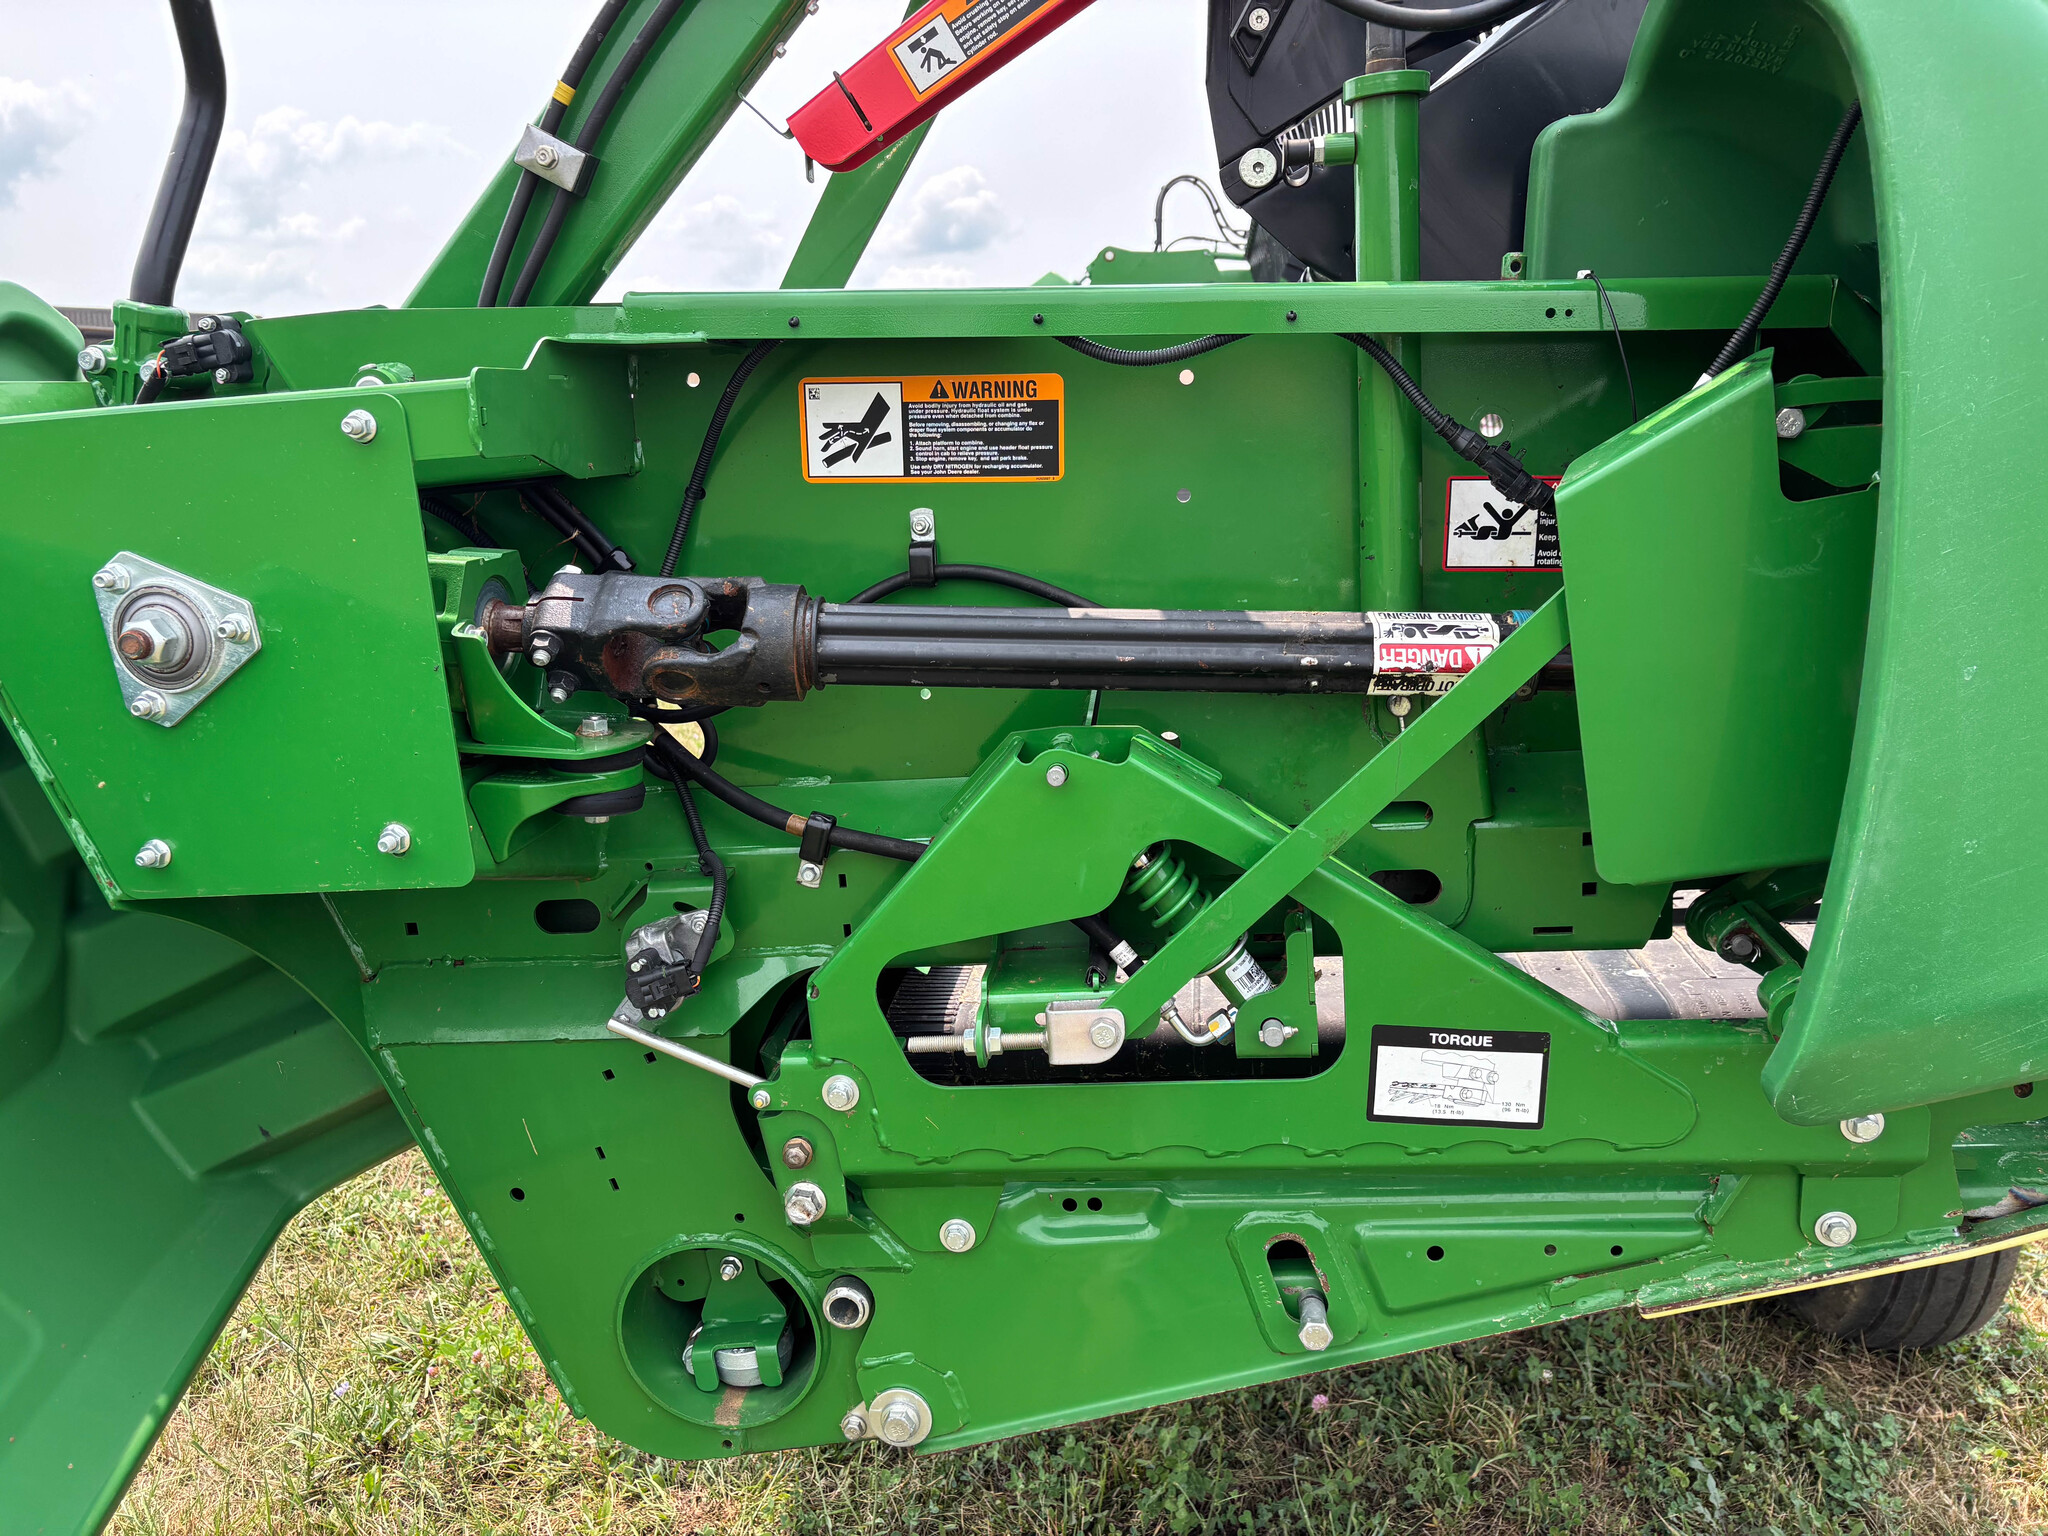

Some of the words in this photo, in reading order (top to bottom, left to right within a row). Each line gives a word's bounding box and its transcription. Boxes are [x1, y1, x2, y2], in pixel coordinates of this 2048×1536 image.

[951, 15, 966, 30] Avoid
[966, 0, 989, 21] crushing
[955, 21, 972, 36] Before
[972, 7, 993, 26] working
[993, 1, 1001, 9] on
[959, 28, 979, 43] engine,
[978, 13, 997, 27] remove
[997, 5, 1007, 18] key,
[963, 39, 974, 49] and
[973, 33, 982, 42] set
[981, 22, 998, 36] safety
[998, 13, 1010, 24] stop
[967, 37, 987, 56] cylinder
[987, 32, 999, 40] rod.
[952, 380, 1037, 399] WARNING
[1540, 518, 1558, 526] injur
[1539, 534, 1557, 542] Keep
[1381, 649, 1462, 668] DANGER
[1435, 681, 1458, 692] OT
[1429, 1033, 1493, 1047] TORQUE
